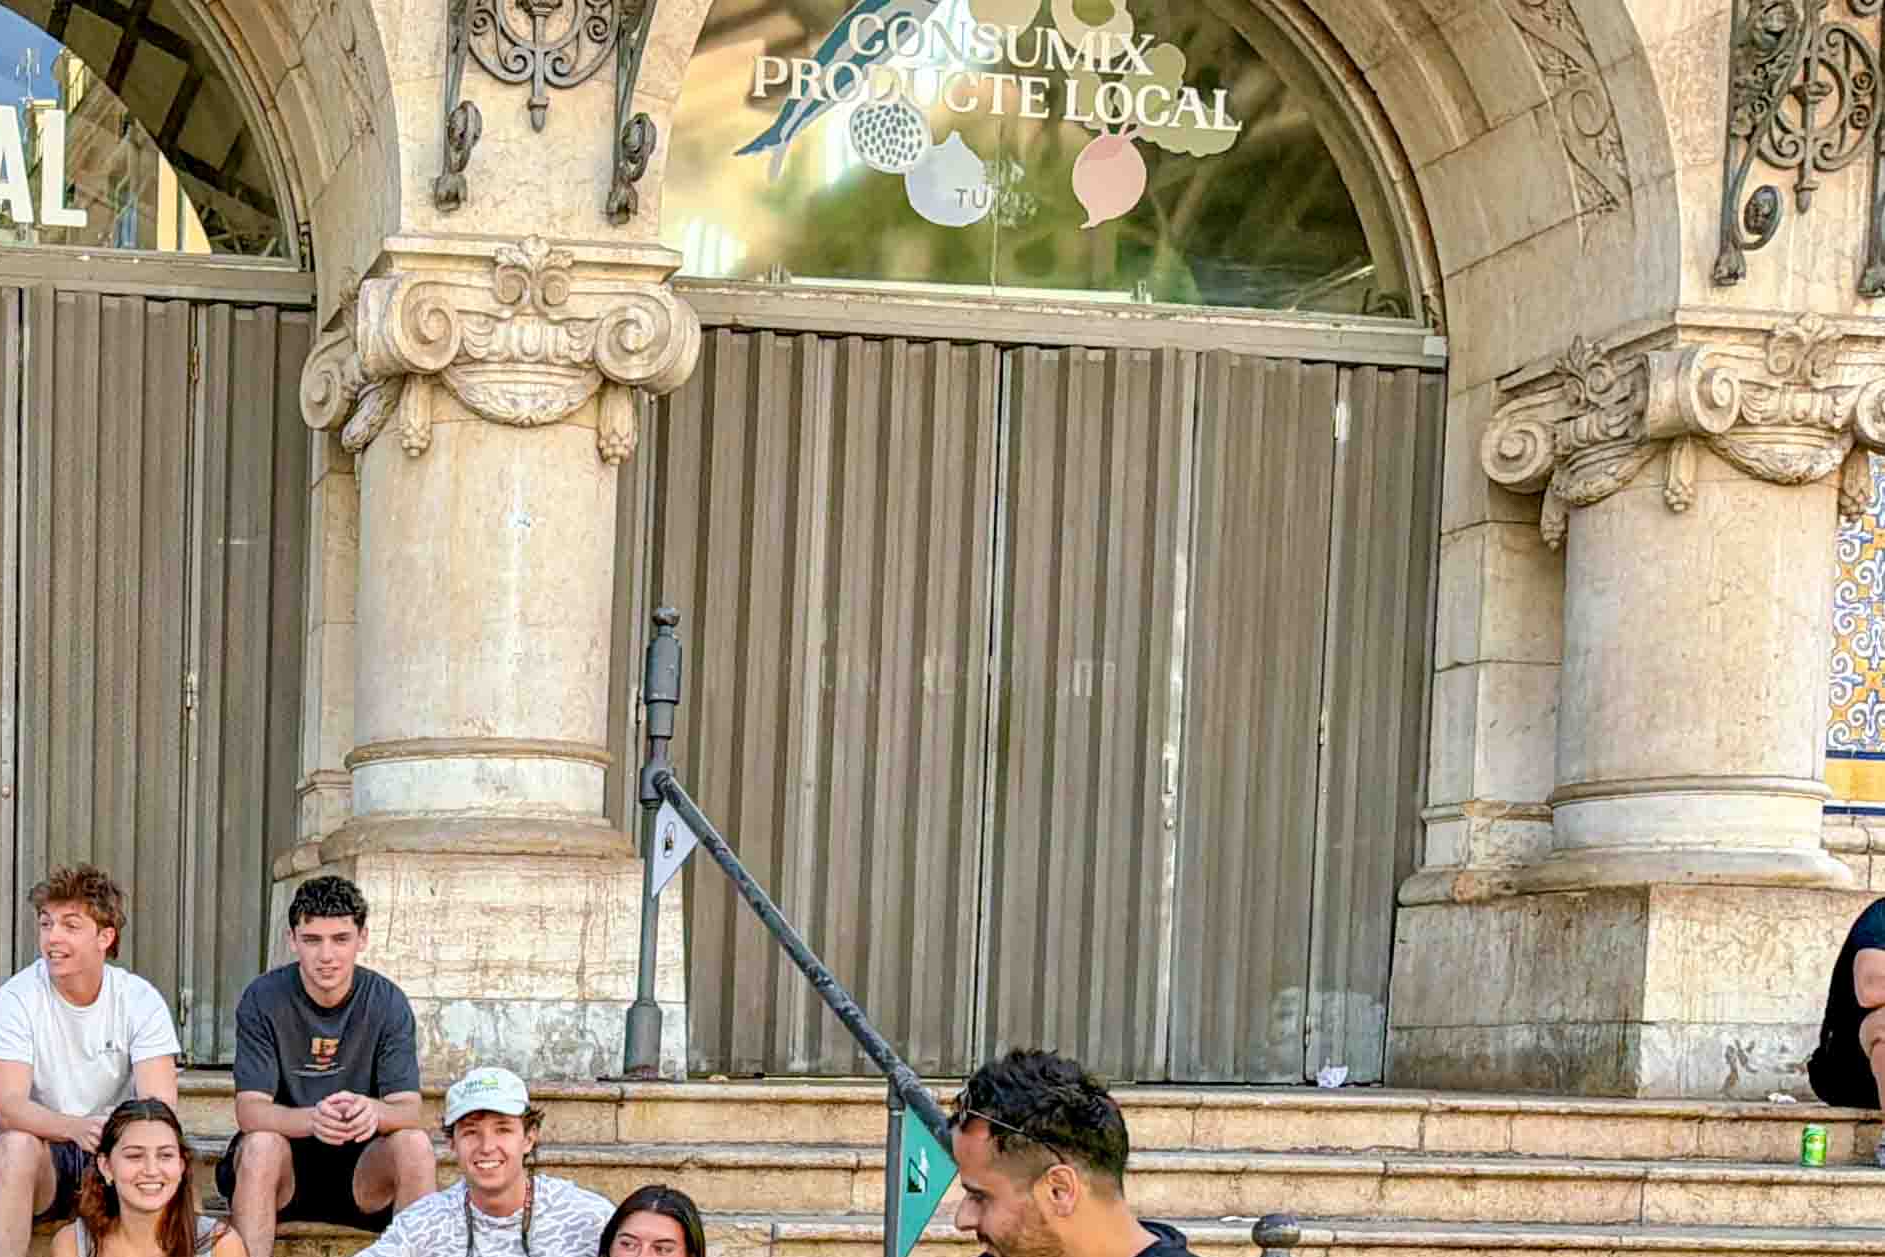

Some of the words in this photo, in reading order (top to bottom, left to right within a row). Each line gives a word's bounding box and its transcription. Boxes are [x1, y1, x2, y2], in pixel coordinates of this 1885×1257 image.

[848, 14, 1155, 77] CONSUMIX
[752, 56, 1050, 118] PRODUCTE
[1064, 80, 1243, 132] LOCAL
